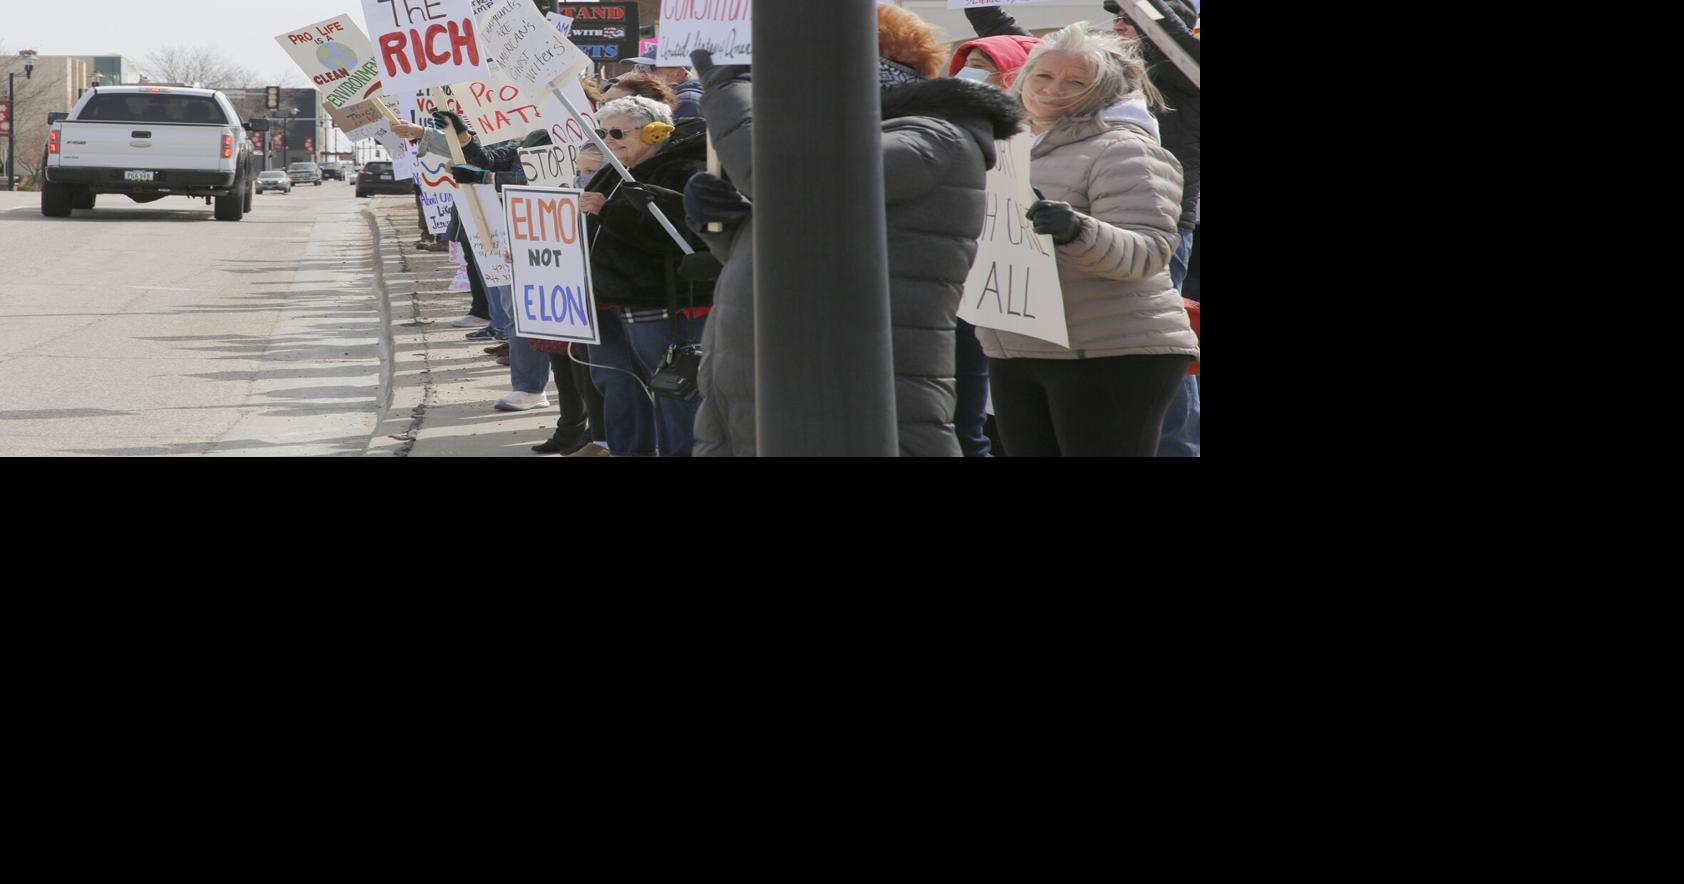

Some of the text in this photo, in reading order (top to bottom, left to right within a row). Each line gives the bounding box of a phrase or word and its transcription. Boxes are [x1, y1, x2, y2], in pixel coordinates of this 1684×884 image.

[288, 21, 345, 45] PRO LIFE
[313, 37, 324, 45] IS
[379, 17, 479, 77] RICH
[572, 29, 603, 37] WITH
[313, 67, 350, 85] CLEAN
[518, 145, 565, 182] STOP
[511, 197, 577, 245] ELMO
[528, 247, 562, 268] NOT
[976, 261, 1036, 319] ALL
[523, 284, 589, 327] ELON
